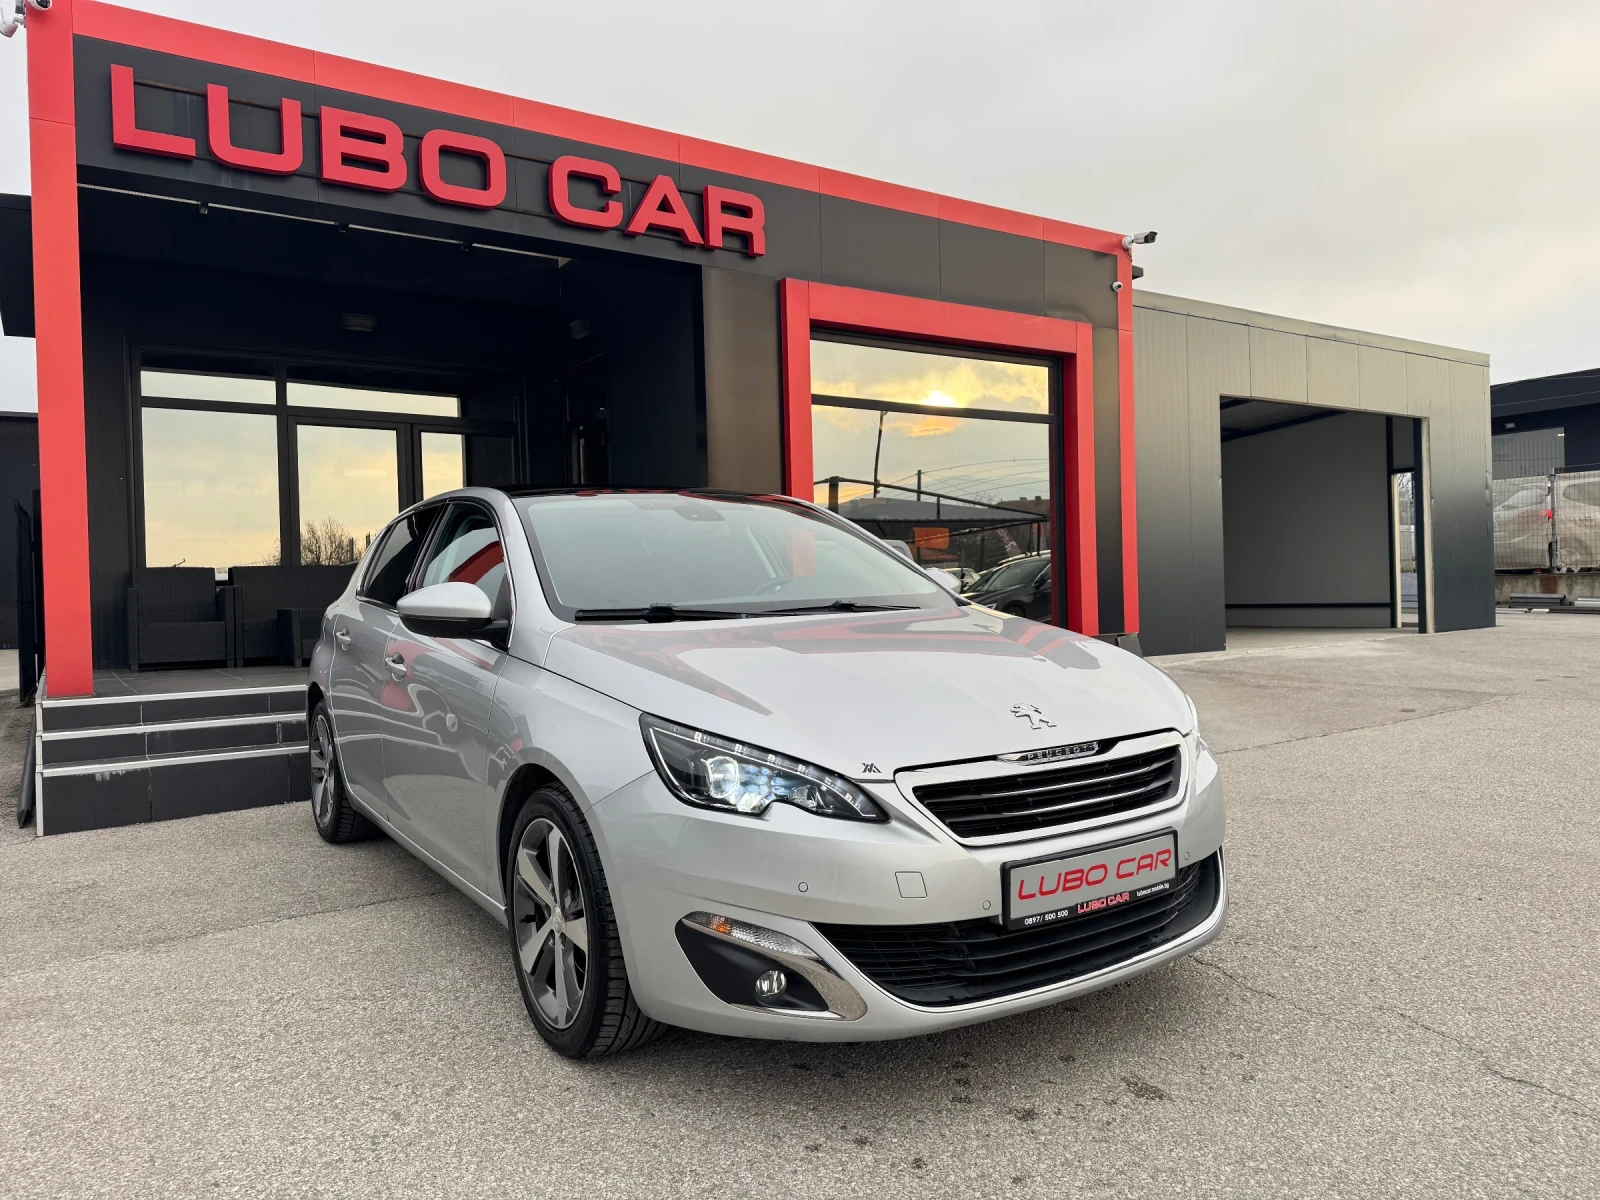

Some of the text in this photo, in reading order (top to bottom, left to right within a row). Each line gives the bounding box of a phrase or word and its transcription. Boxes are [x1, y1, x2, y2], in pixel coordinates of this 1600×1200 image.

[111, 64, 766, 256] LUBO CAR
[1028, 744, 1087, 760] PEUGEOT
[1018, 849, 1172, 900] LUBO CAR
[1077, 892, 1130, 914] LUBO CAR
[1045, 912, 1056, 921] 500
[1057, 909, 1069, 917] 500
